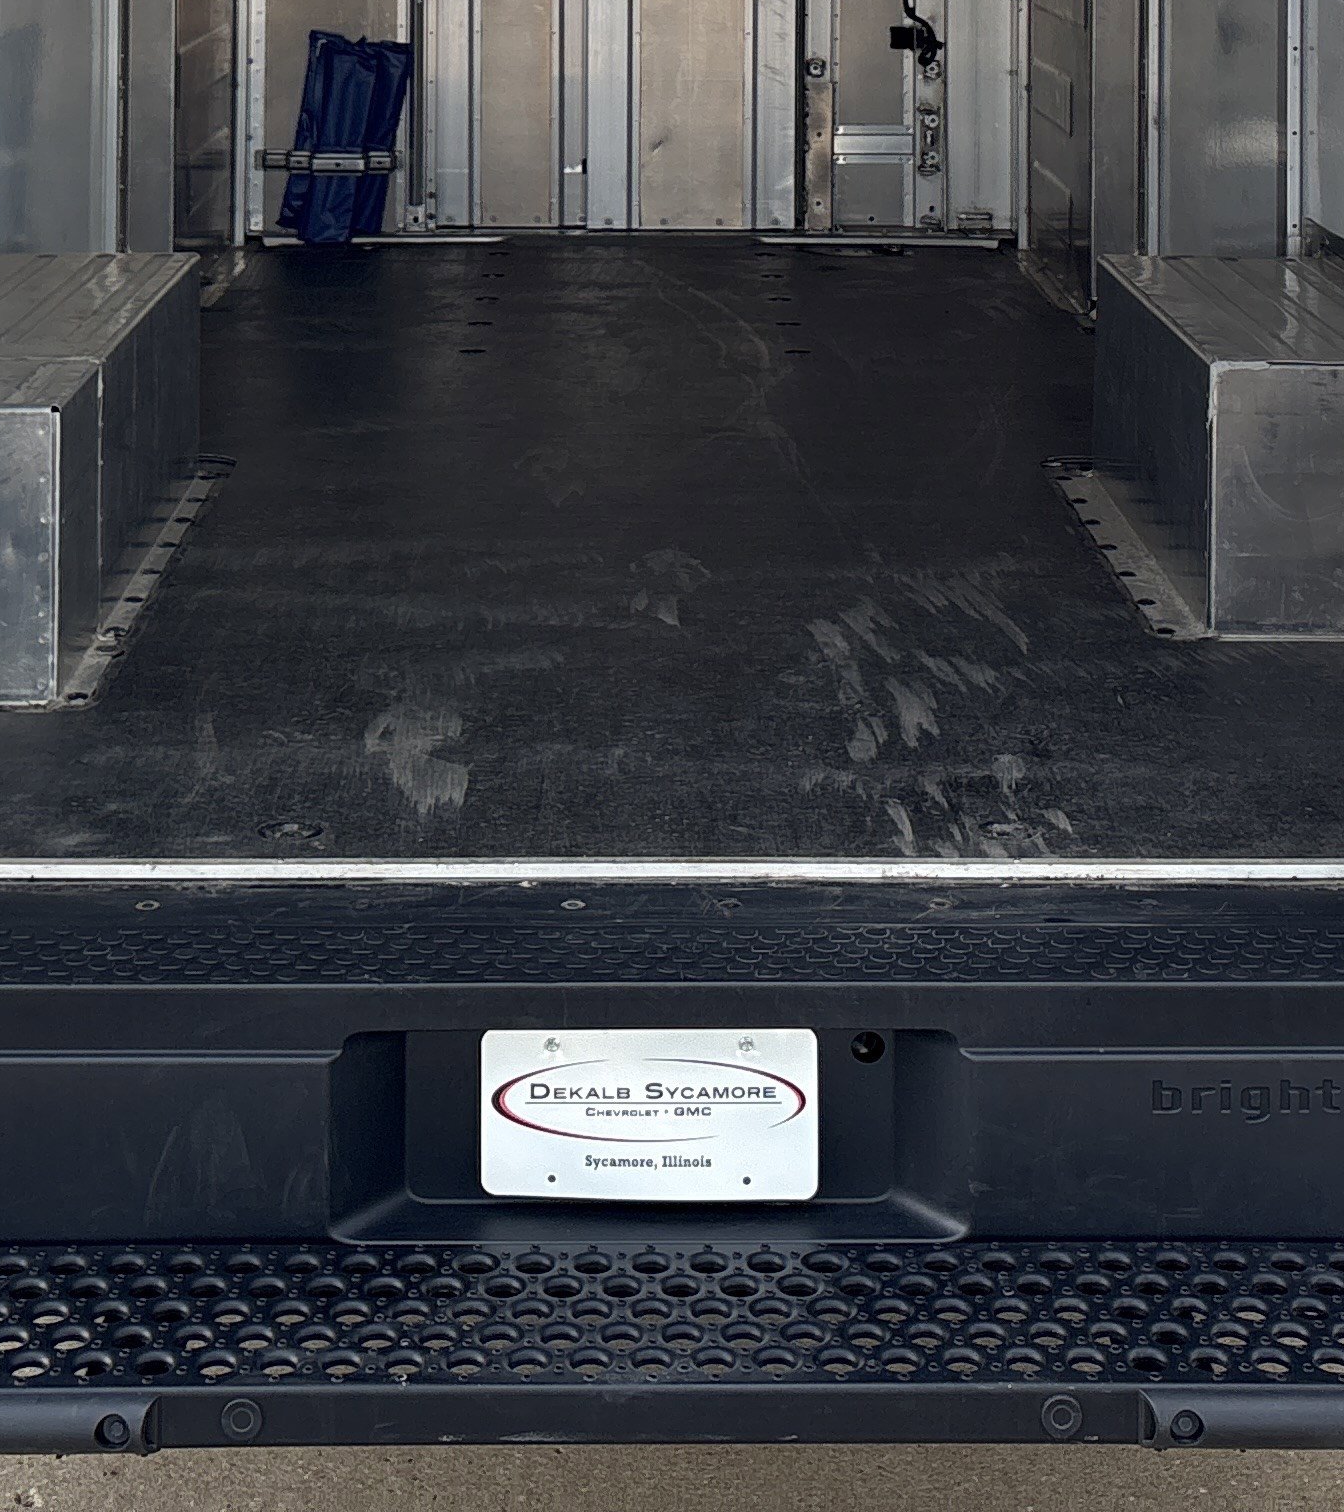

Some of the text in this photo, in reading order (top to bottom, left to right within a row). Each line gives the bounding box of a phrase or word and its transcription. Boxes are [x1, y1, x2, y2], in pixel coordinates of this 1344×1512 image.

[529, 1082, 777, 1100] DEKALB SYCAMORE
[585, 1106, 712, 1117] CHEVROLET GMC
[584, 1155, 713, 1170] Sycamore, Illinois
